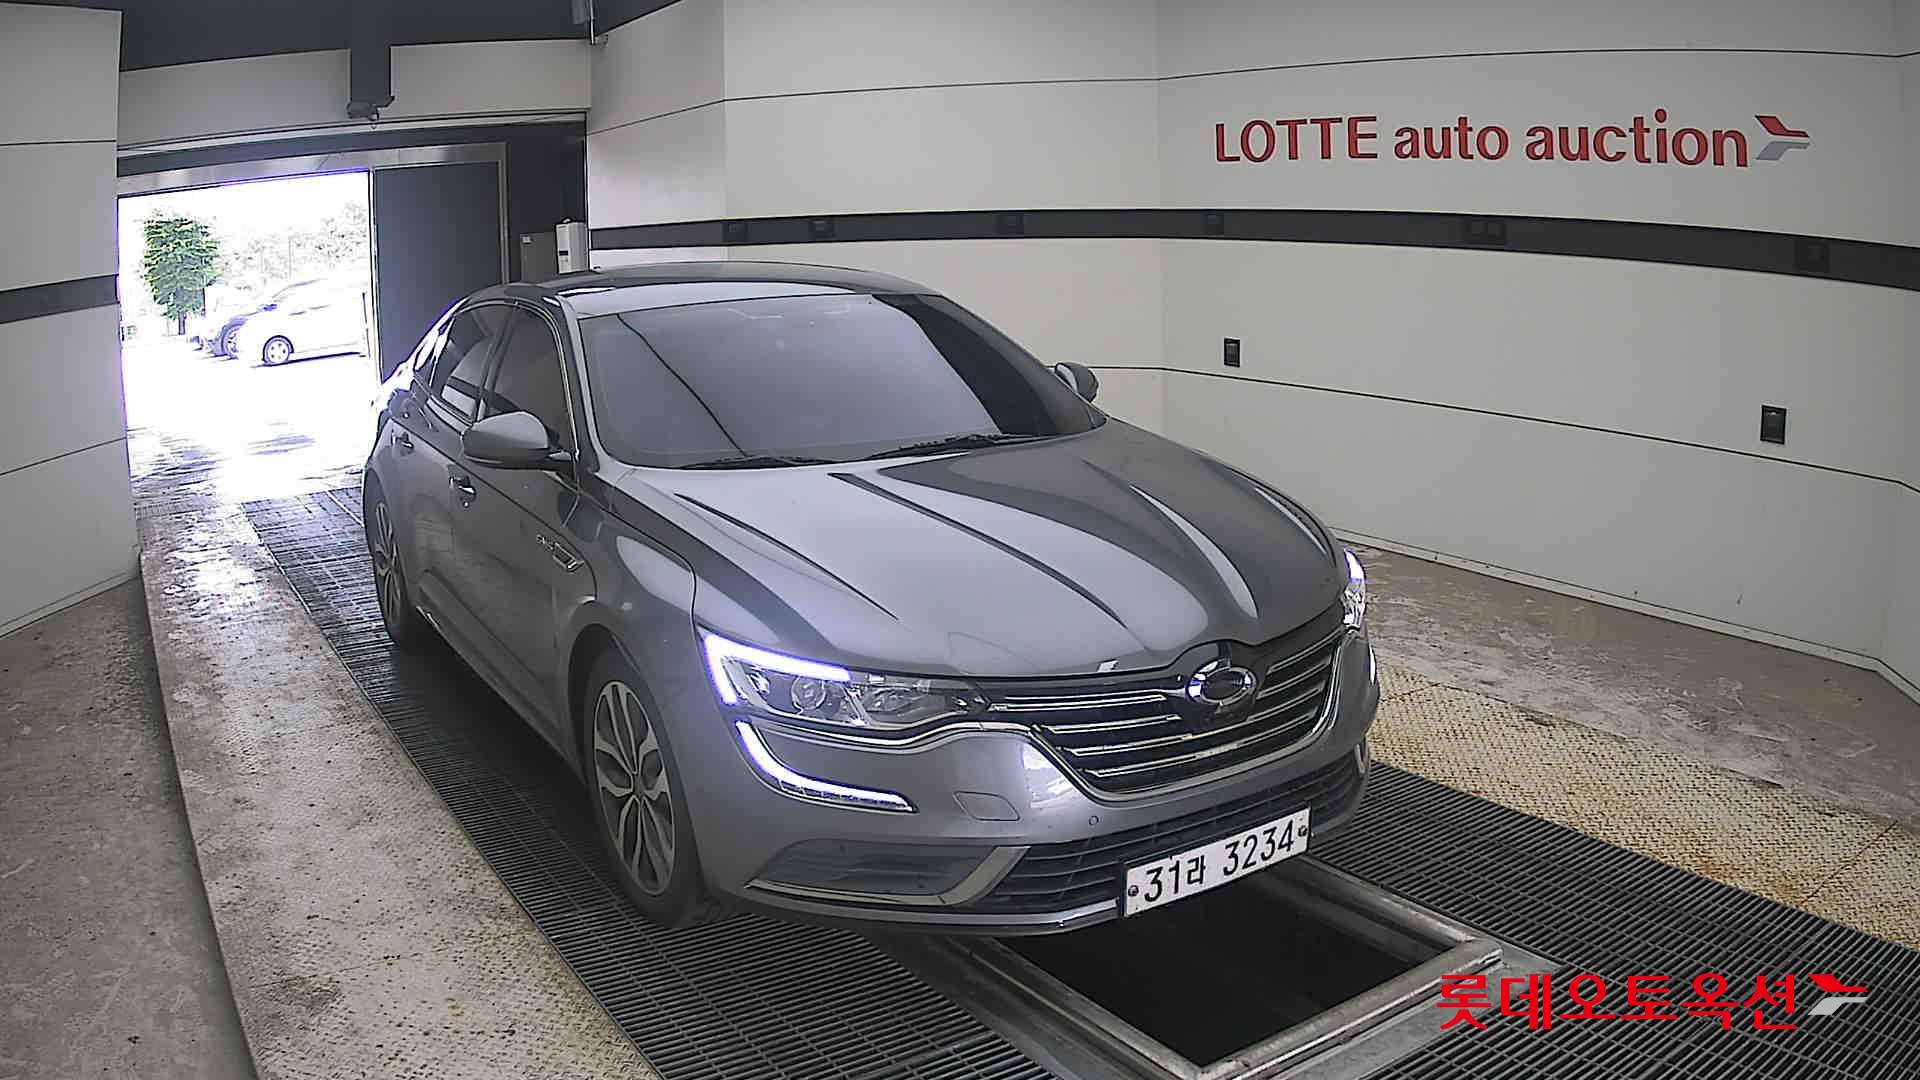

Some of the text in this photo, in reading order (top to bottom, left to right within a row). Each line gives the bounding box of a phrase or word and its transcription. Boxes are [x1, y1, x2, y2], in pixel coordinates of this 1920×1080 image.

[1214, 108, 1749, 168] LOTTE auto auction
[1143, 819, 1295, 902] 31라 3234
